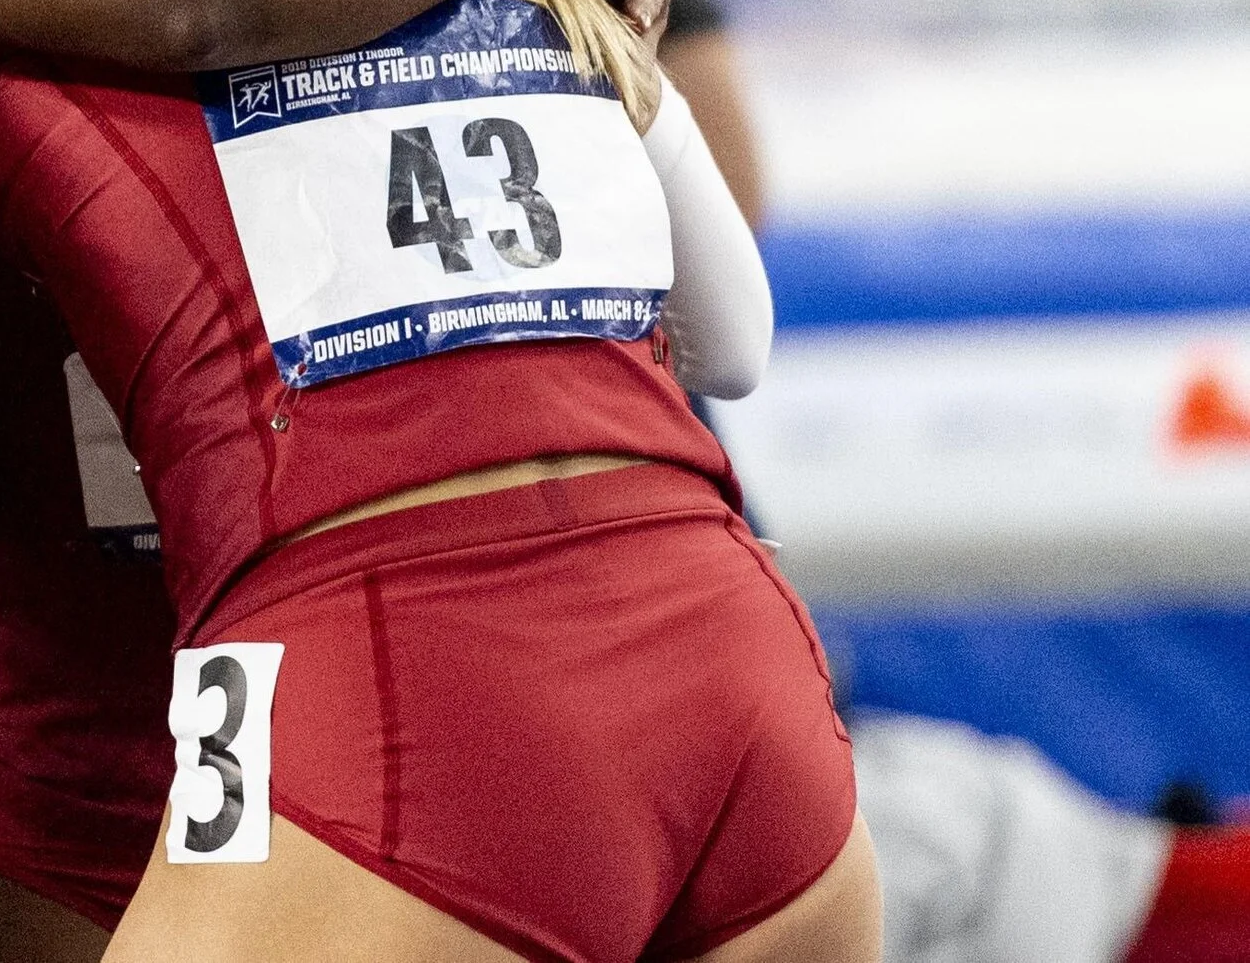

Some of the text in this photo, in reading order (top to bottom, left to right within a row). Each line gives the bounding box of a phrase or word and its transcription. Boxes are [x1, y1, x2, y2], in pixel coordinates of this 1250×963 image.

[281, 65, 357, 100] TRACK
[358, 62, 375, 87] &
[378, 55, 436, 84] FIELD
[309, 51, 357, 69] DIVISION
[358, 50, 364, 61] I
[365, 47, 405, 60] INDOOR
[341, 92, 352, 100] AL
[386, 117, 563, 275] 43
[313, 320, 400, 363] DIVISION
[404, 317, 412, 339] I
[427, 300, 548, 334] BIRMINGHAM,
[551, 300, 569, 321] AL
[581, 299, 632, 321] MARCH
[184, 655, 247, 853] 3
